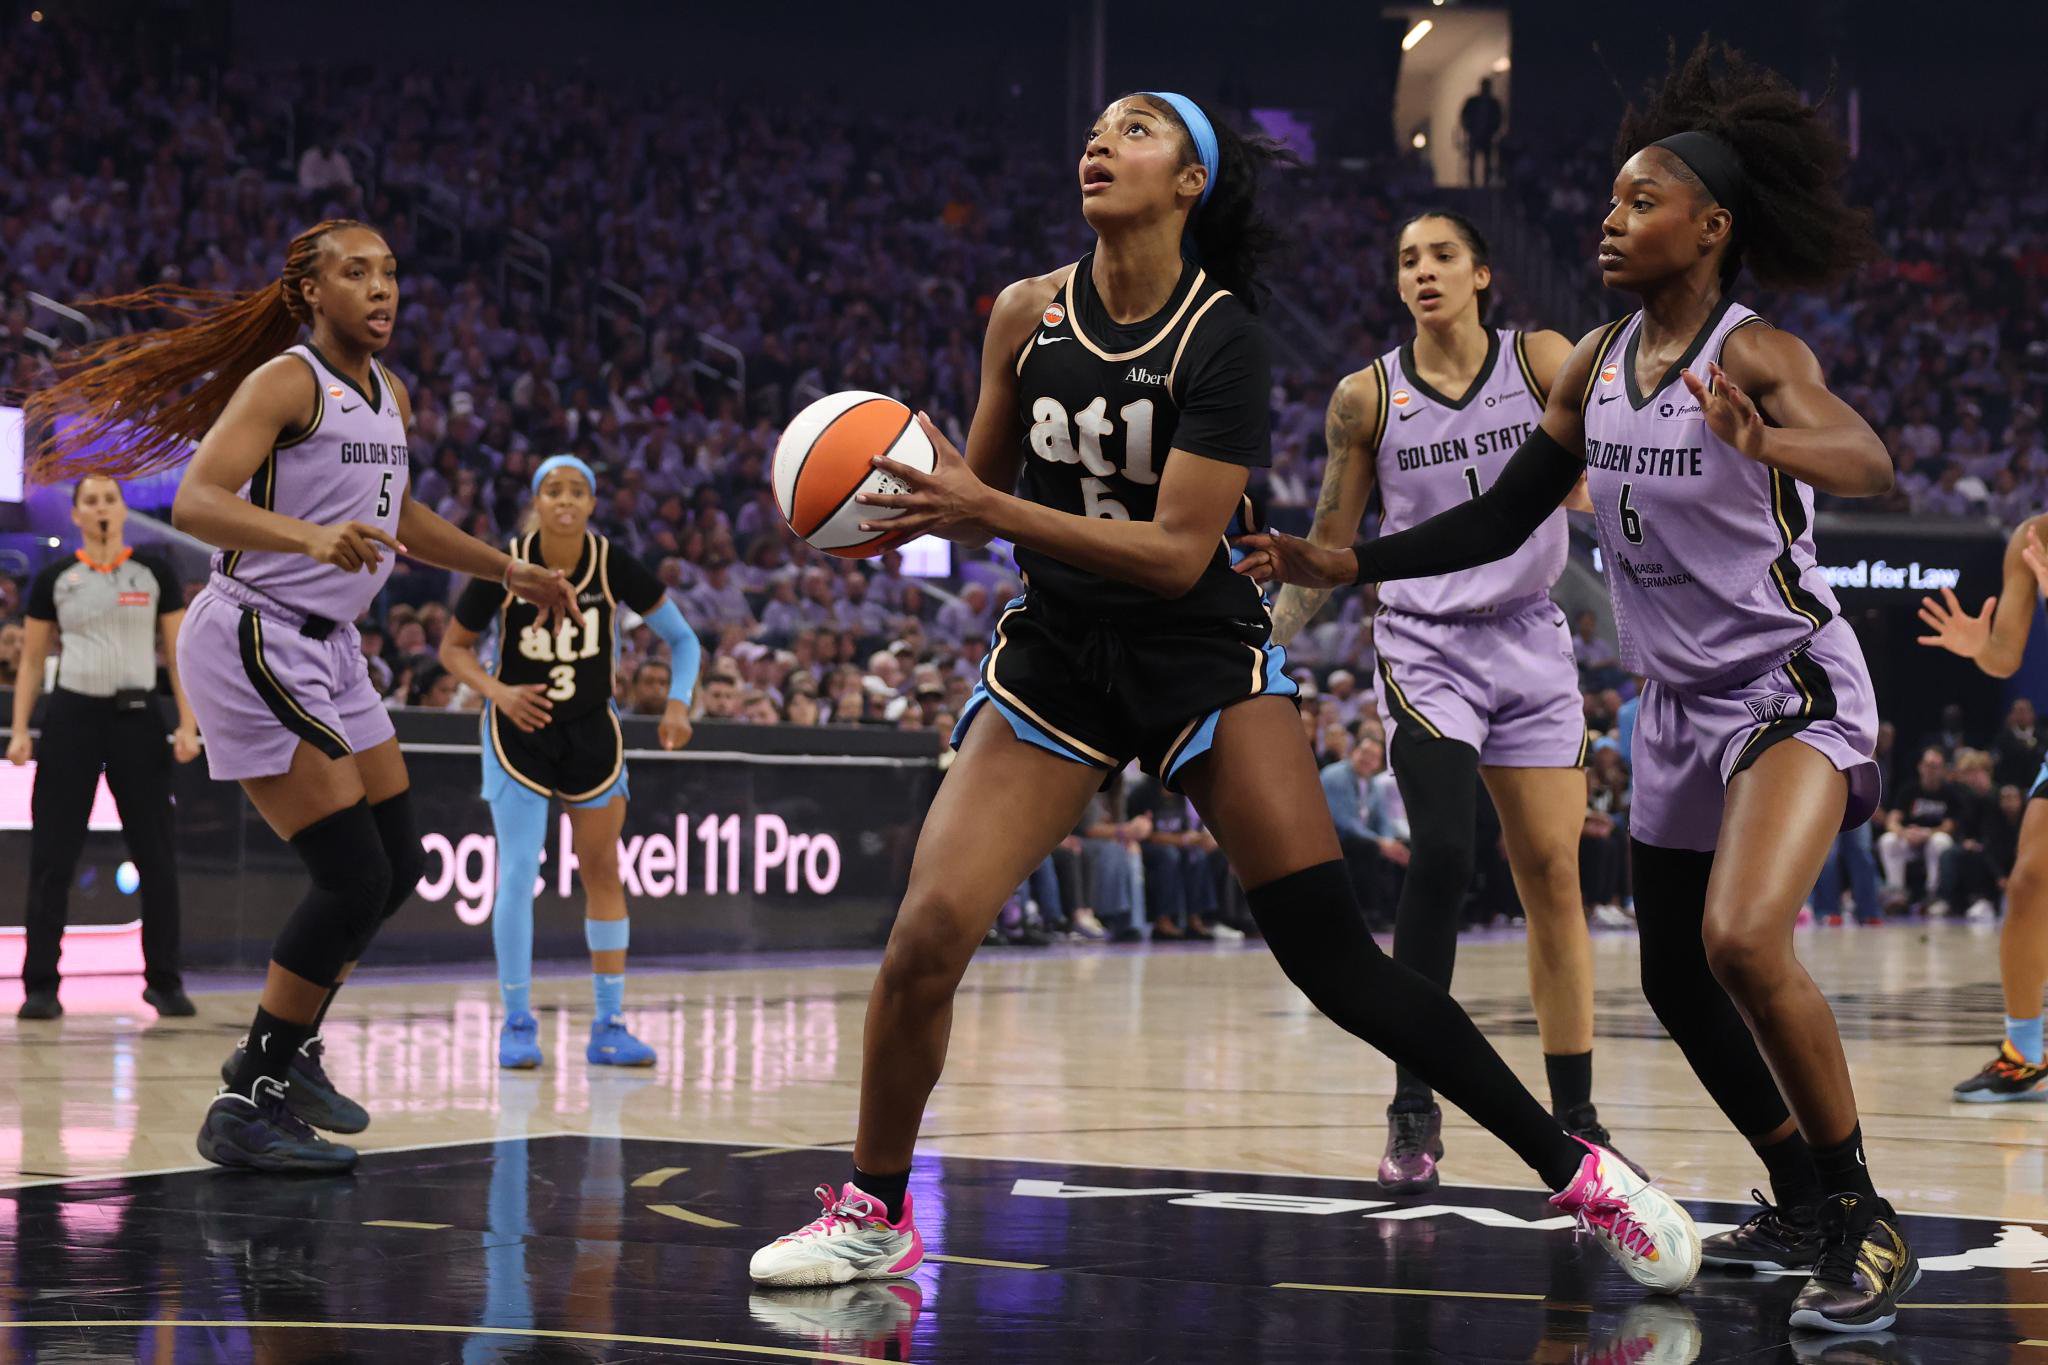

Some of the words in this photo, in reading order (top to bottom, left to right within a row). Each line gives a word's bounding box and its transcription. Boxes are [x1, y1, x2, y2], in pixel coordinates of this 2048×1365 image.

[1125, 366, 1168, 387] Albert
[341, 442, 388, 465] GOLDEN
[391, 444, 408, 466] STA
[1029, 396, 1159, 485] atl
[1397, 437, 1469, 471] GOLDEN
[1474, 421, 1533, 456] STATE
[1635, 446, 1702, 476] STATE
[376, 470, 394, 519] 5
[1462, 465, 1482, 500] 1
[1618, 482, 1645, 545] 6
[1633, 562, 1665, 574] KAISER
[1870, 560, 1908, 588] for
[1910, 562, 1960, 589] Law
[518, 606, 601, 662] atl
[546, 664, 577, 701] 3
[695, 813, 741, 895] 11
[754, 813, 842, 896] Pro
[1011, 1178, 1741, 1241] NBA
